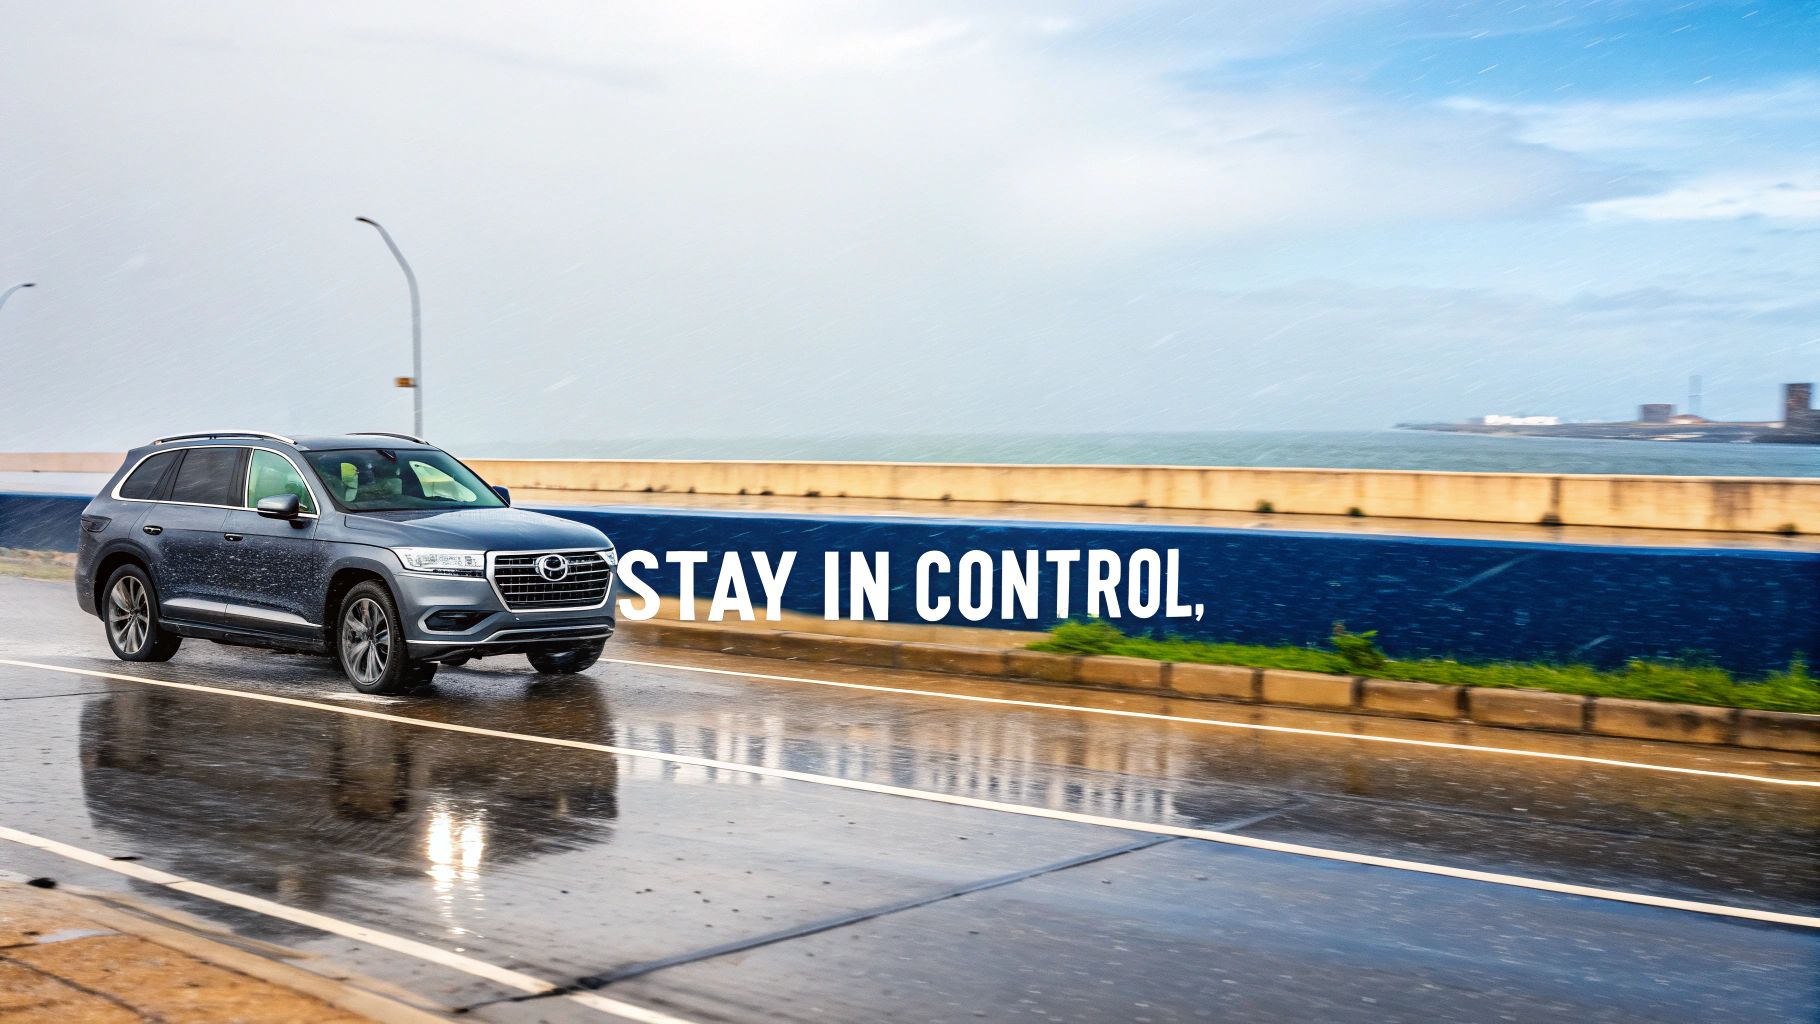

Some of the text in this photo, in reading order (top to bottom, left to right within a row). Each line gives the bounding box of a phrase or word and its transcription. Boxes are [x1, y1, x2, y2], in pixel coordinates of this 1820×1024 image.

[617, 548, 1205, 622] STAY IN CONTROL,
